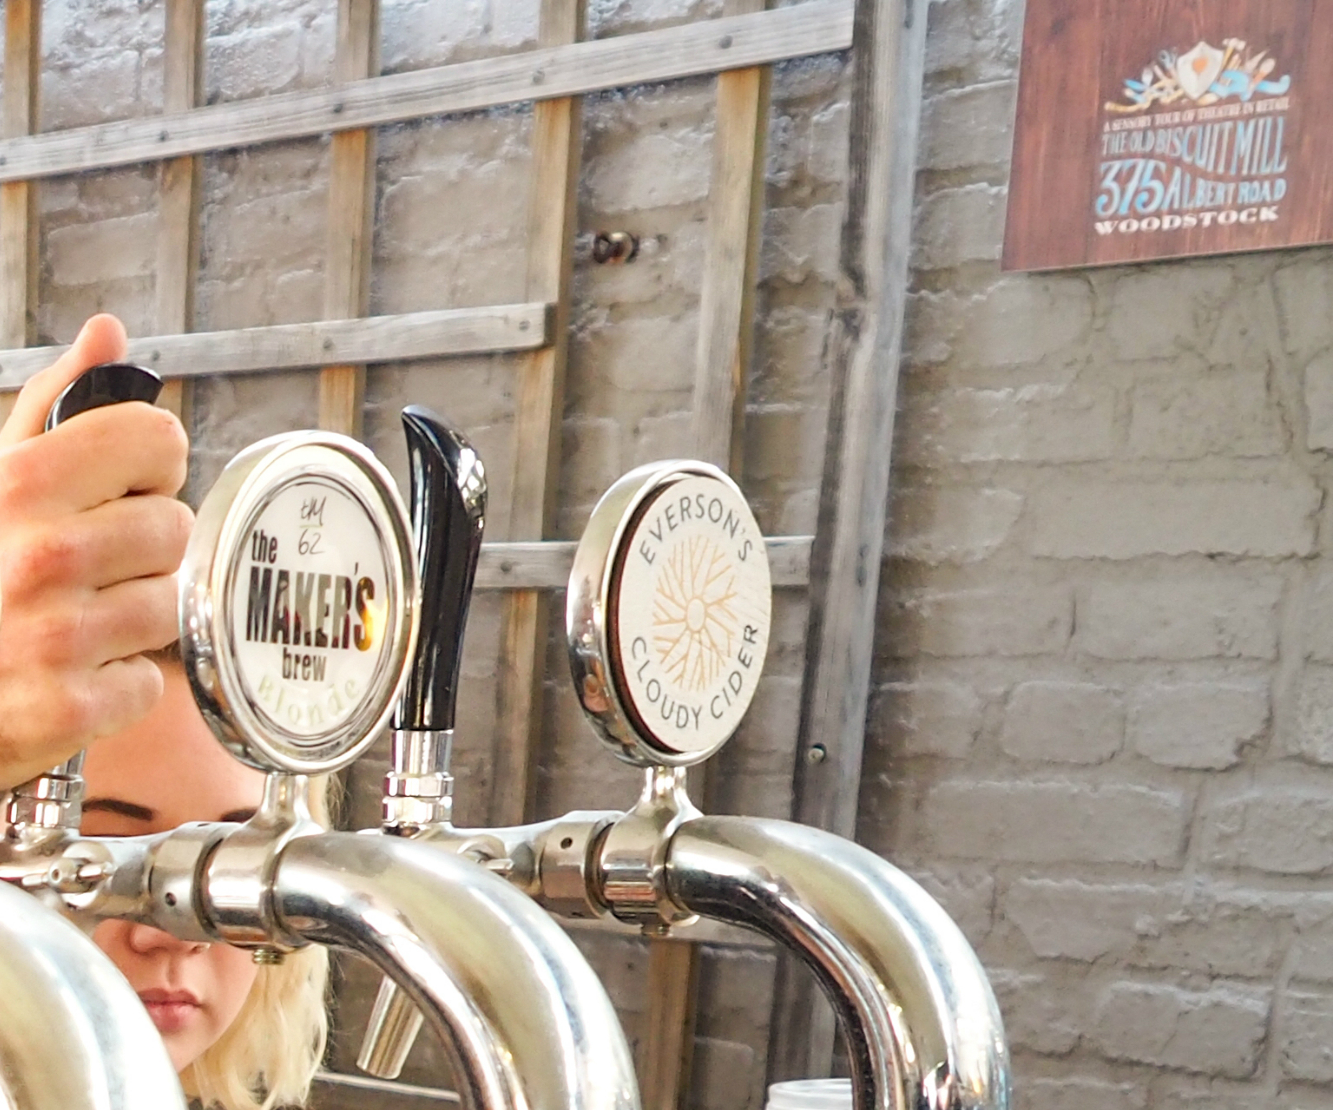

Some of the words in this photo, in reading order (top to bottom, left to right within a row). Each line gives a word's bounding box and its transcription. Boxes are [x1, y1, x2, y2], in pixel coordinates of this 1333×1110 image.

[1101, 131, 1126, 156] THE
[1130, 128, 1155, 152] OLD
[1156, 120, 1234, 175] BISCUIT
[1230, 115, 1288, 176] MILL
[1095, 158, 1167, 218] 375
[1161, 165, 1236, 210] ALBERT
[1237, 177, 1288, 205] ROAD
[1094, 205, 1280, 236] WOODSTOCK
[252, 528, 278, 564] the
[639, 493, 754, 565] EVERSON'S
[245, 561, 376, 652] MAKER'S
[282, 646, 328, 682] brew
[632, 635, 703, 731] CLOUDY
[709, 623, 759, 720] CIDER
